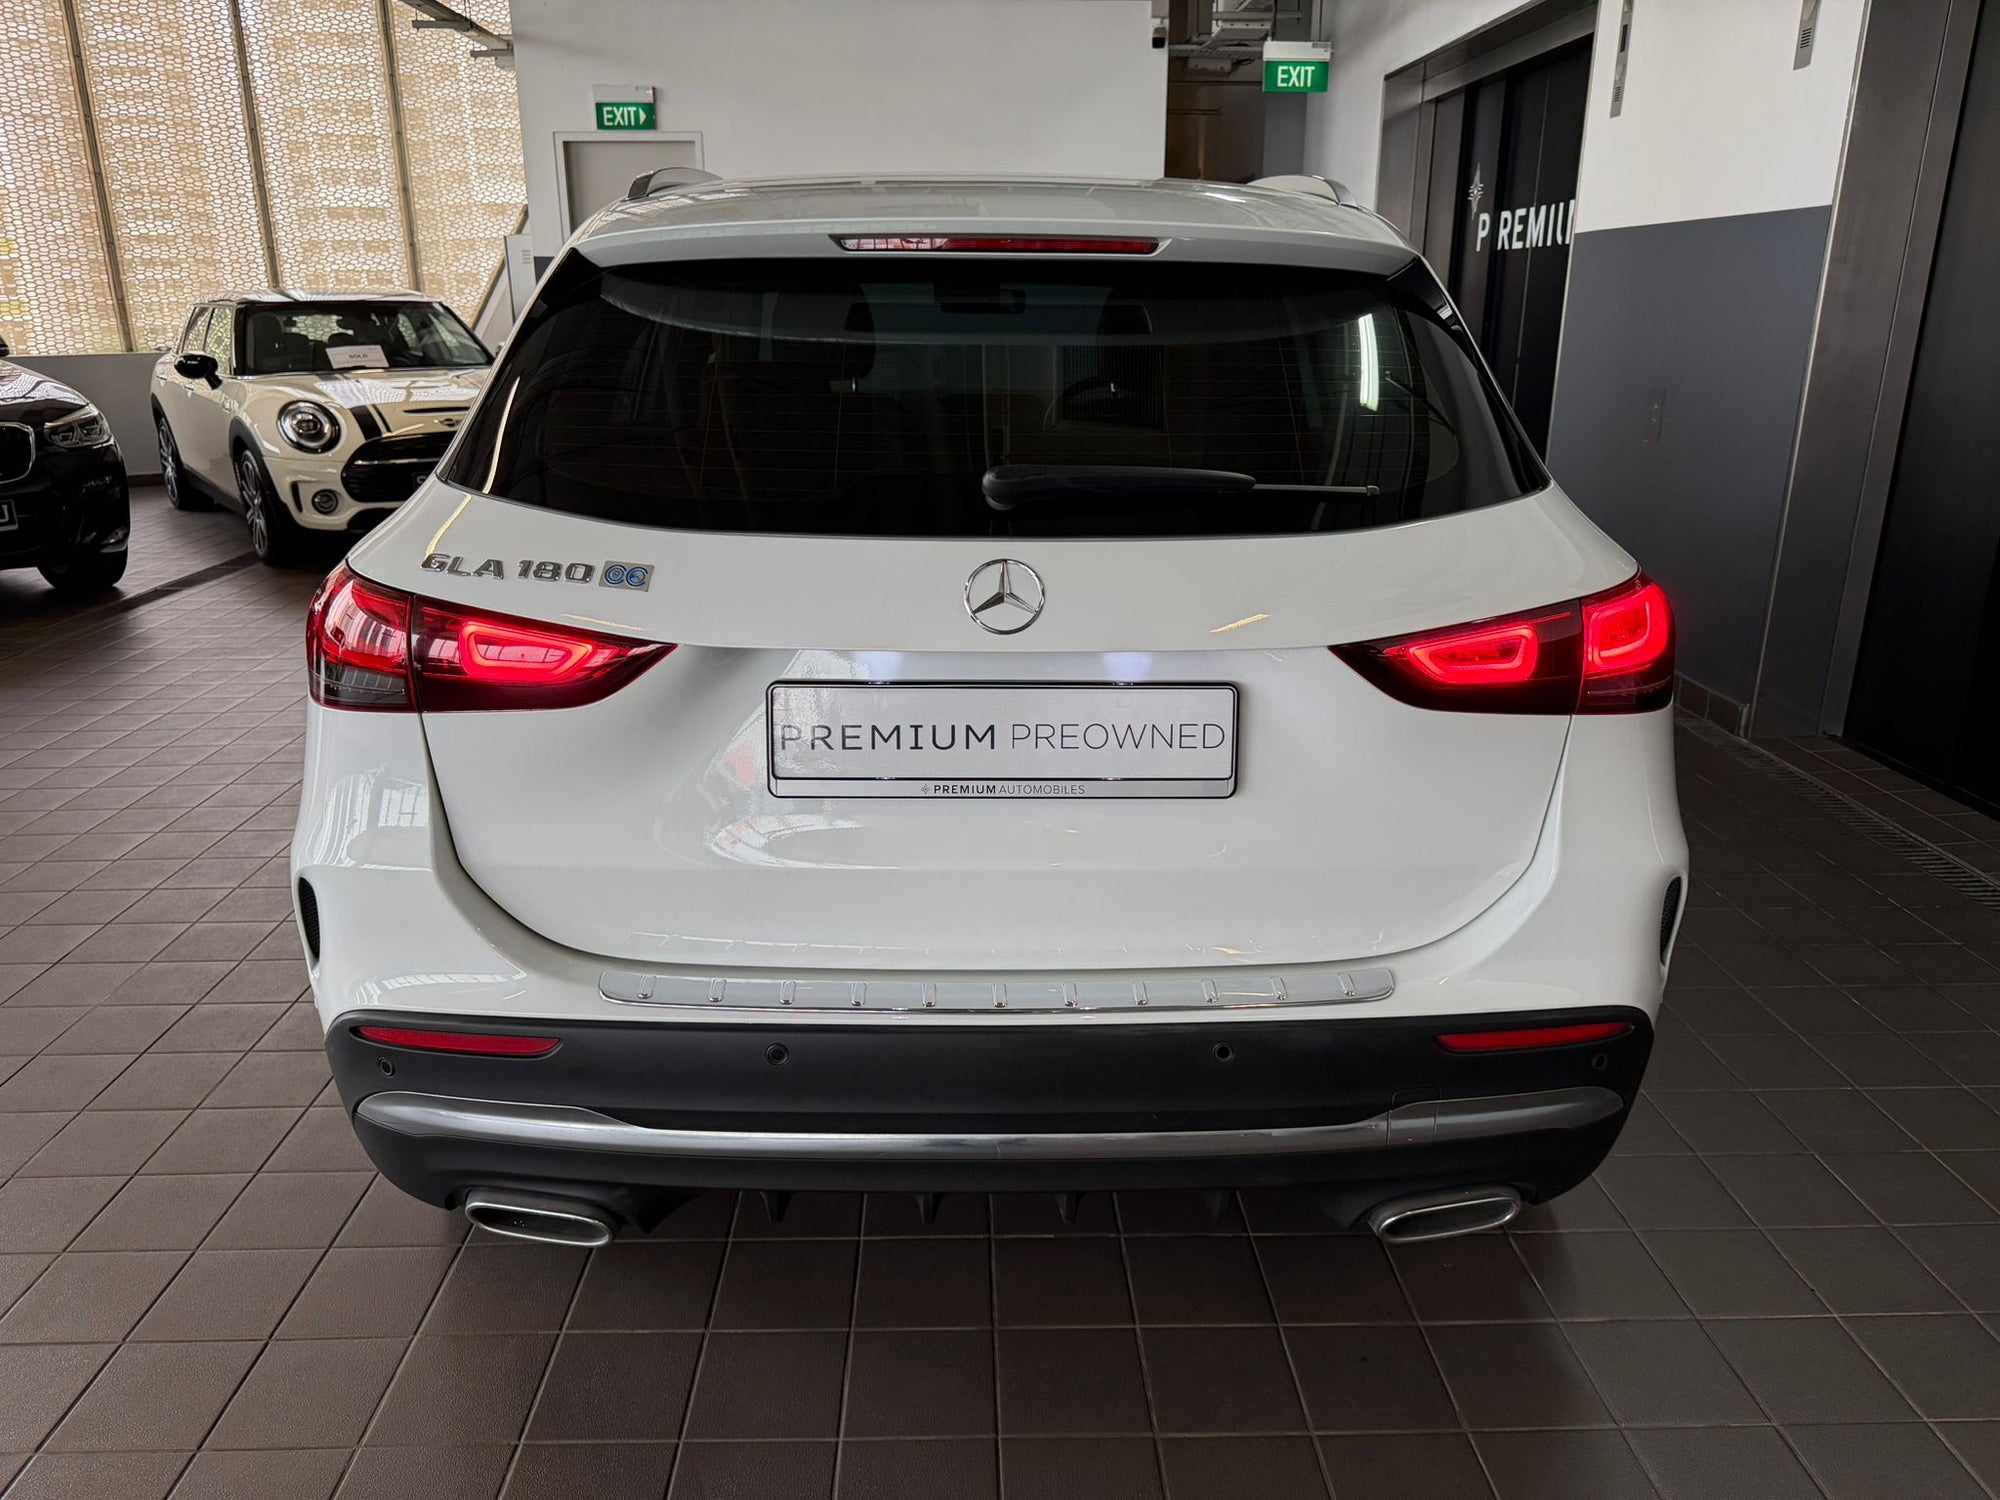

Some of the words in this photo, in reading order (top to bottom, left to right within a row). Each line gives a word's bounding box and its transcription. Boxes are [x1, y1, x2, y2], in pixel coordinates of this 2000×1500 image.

[1277, 66, 1315, 87] EXIT
[603, 107, 636, 126] EXIT
[420, 553, 504, 580] GLA
[517, 560, 595, 583] 180
[781, 724, 995, 750] PREMIUM
[1012, 723, 1225, 749] PREOWNED
[934, 784, 996, 794] PREMIUM
[999, 784, 1085, 794] AUTOMOBILES
